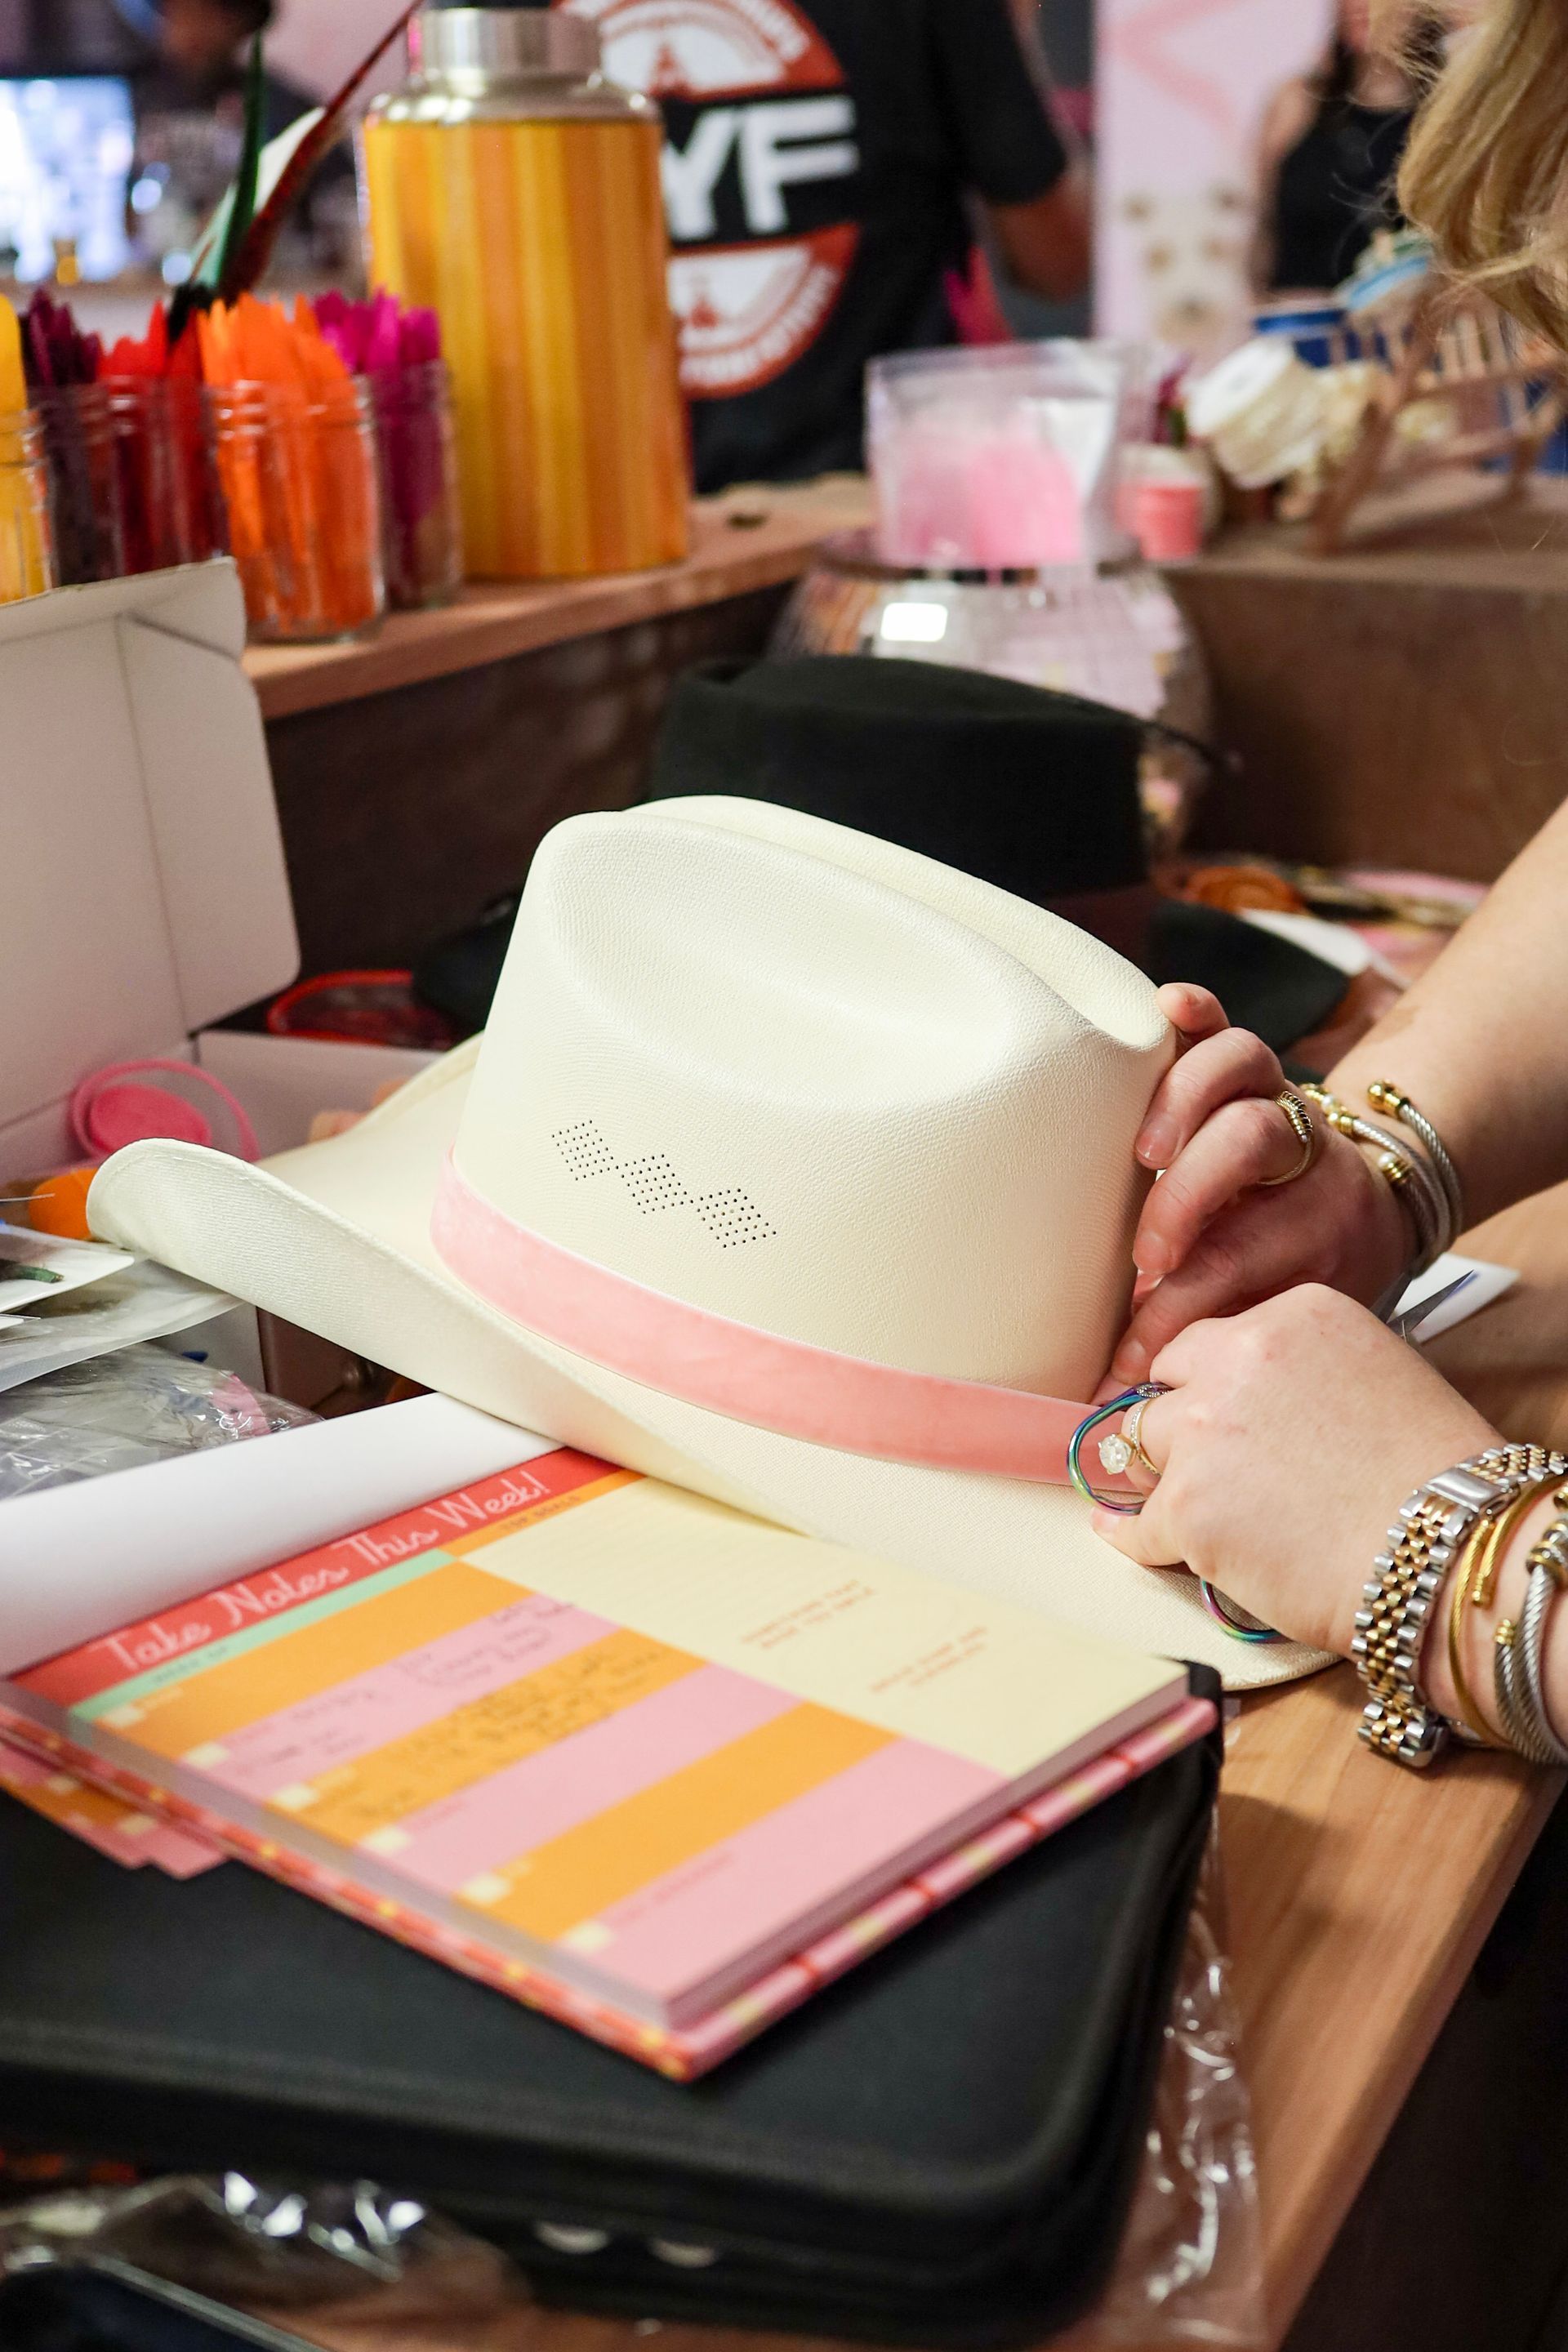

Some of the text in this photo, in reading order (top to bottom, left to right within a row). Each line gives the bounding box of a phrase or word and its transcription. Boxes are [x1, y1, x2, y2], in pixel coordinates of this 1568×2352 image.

[88, 1620, 212, 1670] Take
[207, 1567, 349, 1627] Notes
[330, 1530, 439, 1566] This
[424, 1469, 552, 1529] Week!
